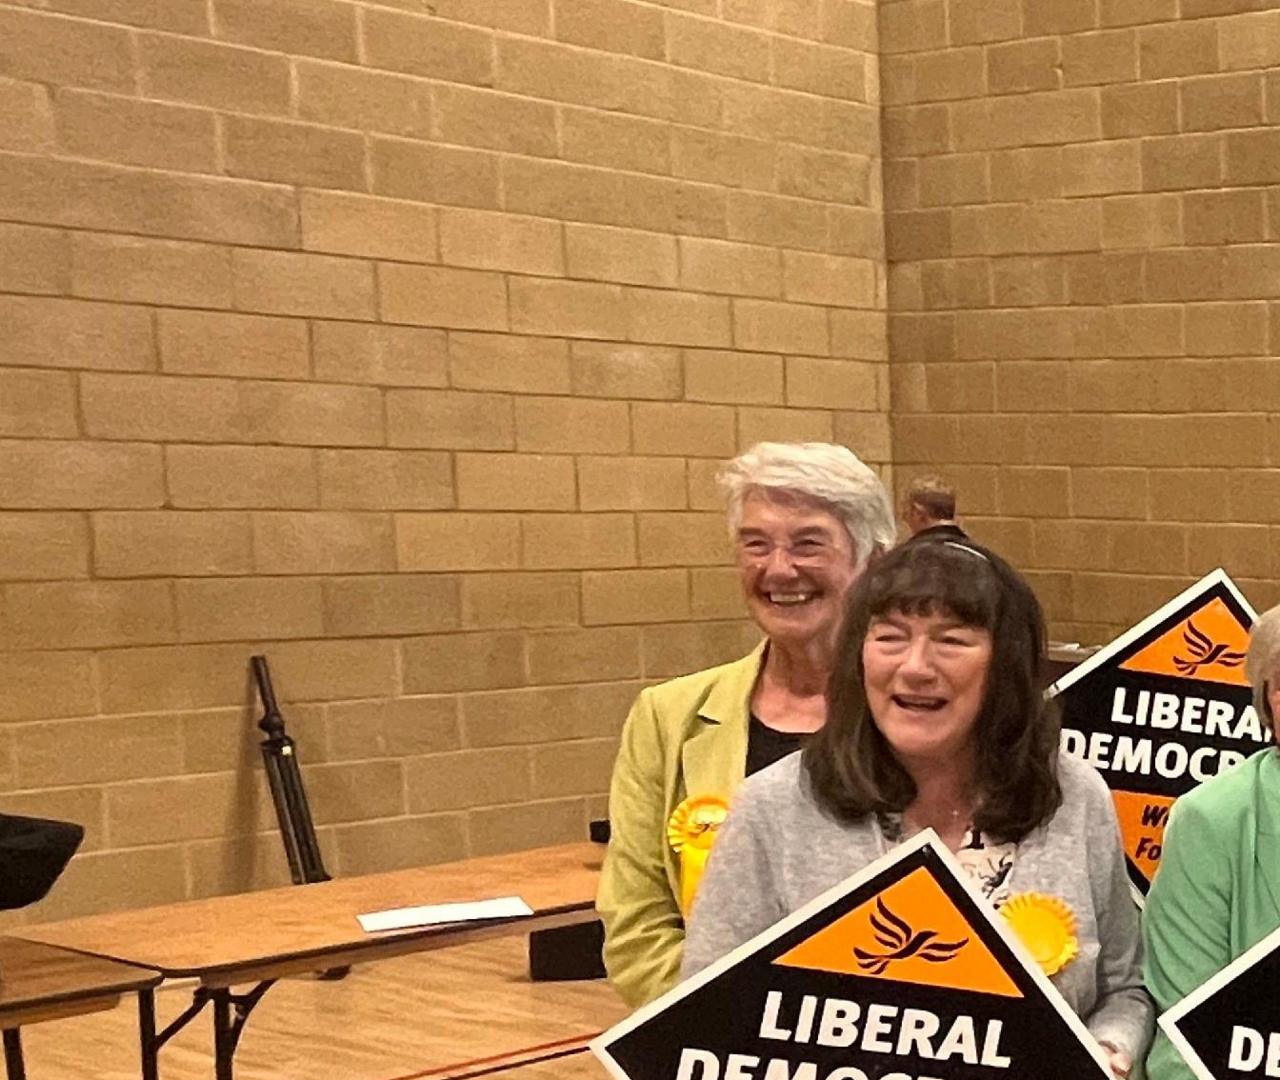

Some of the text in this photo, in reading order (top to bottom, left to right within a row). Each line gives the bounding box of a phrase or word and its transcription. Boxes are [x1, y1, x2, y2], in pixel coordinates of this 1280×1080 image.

[1111, 687, 1273, 743] LIBERA
[1135, 837, 1163, 860] Fo
[759, 991, 1012, 1068] LIBERAL
